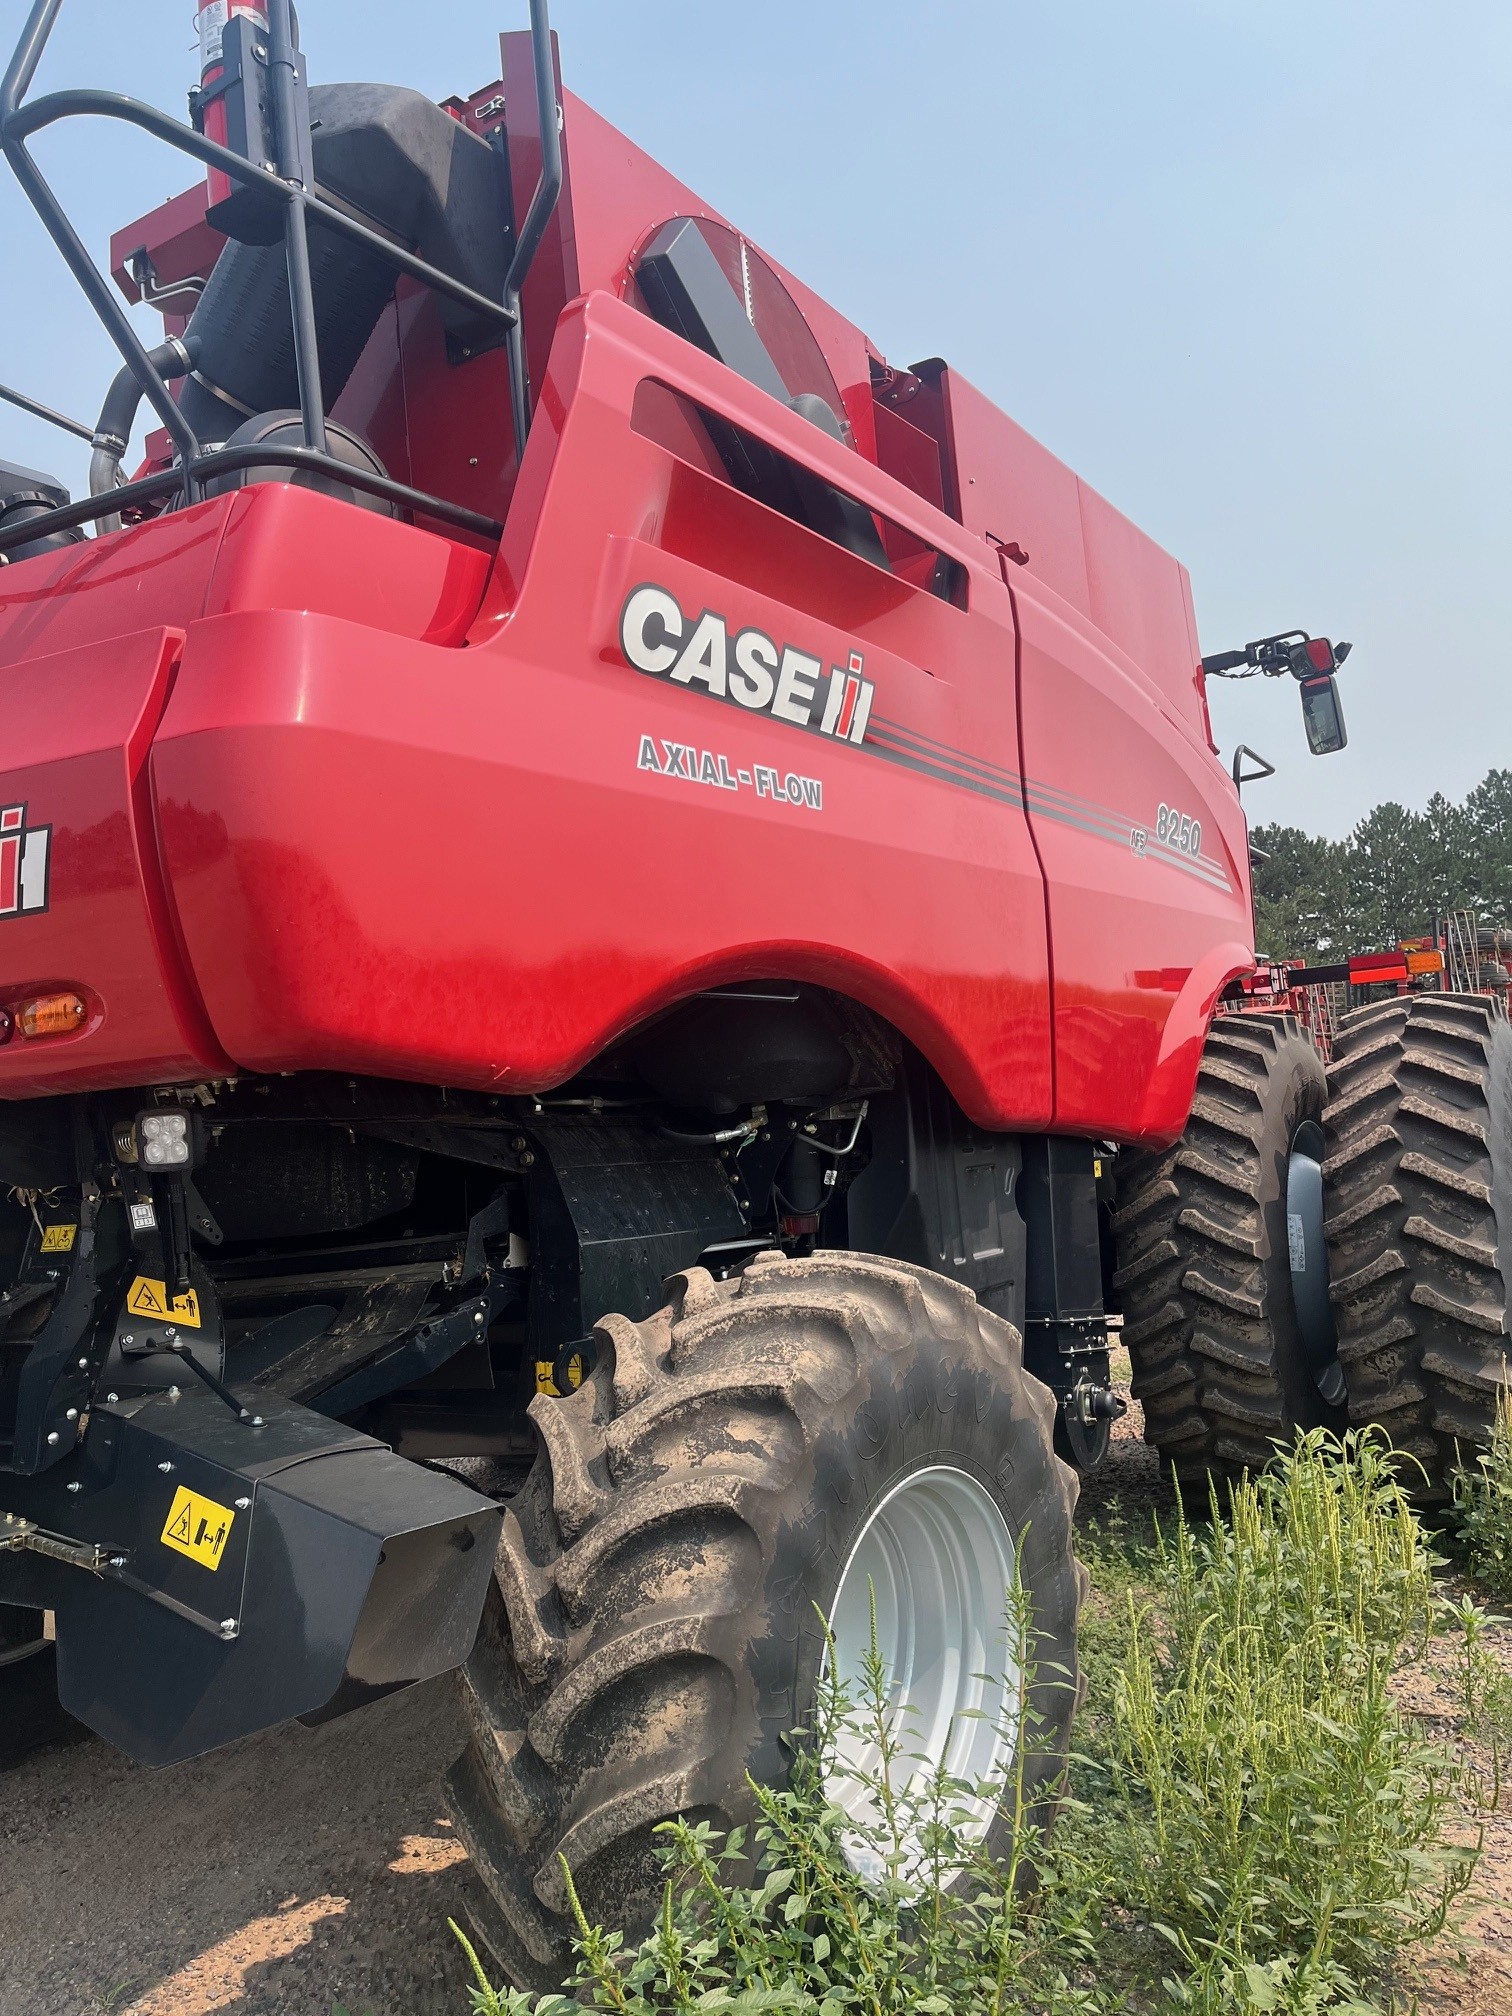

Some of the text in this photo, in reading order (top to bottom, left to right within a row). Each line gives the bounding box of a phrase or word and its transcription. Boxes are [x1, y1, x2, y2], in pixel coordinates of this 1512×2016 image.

[620, 585, 822, 726] CASE
[637, 734, 823, 811] AXIAL-FLOW
[1130, 828, 1147, 852] AFS
[1156, 802, 1202, 859] 8250
